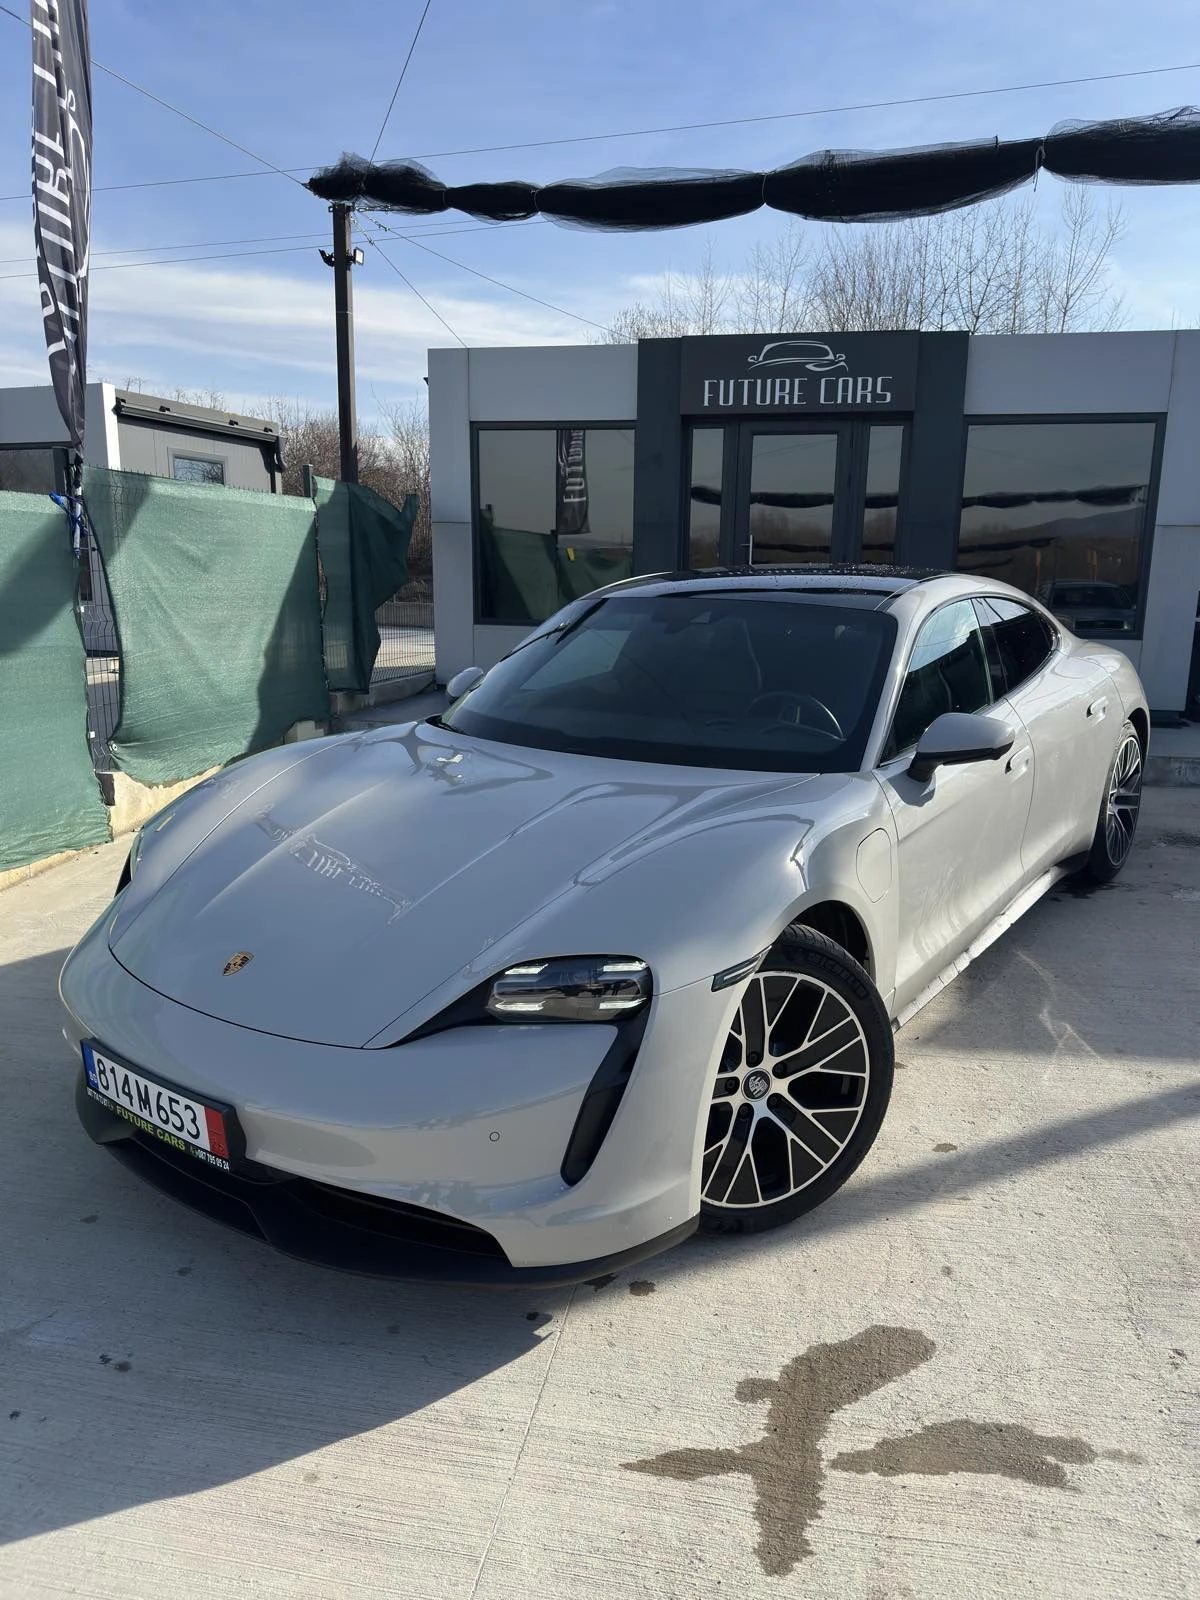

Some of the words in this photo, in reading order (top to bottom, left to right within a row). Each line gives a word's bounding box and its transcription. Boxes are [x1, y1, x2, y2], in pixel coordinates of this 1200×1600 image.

[703, 378, 808, 406] FUTURE
[819, 376, 893, 404] CARS
[116, 1106, 155, 1135] FUTURE
[156, 1129, 186, 1151] CARS
